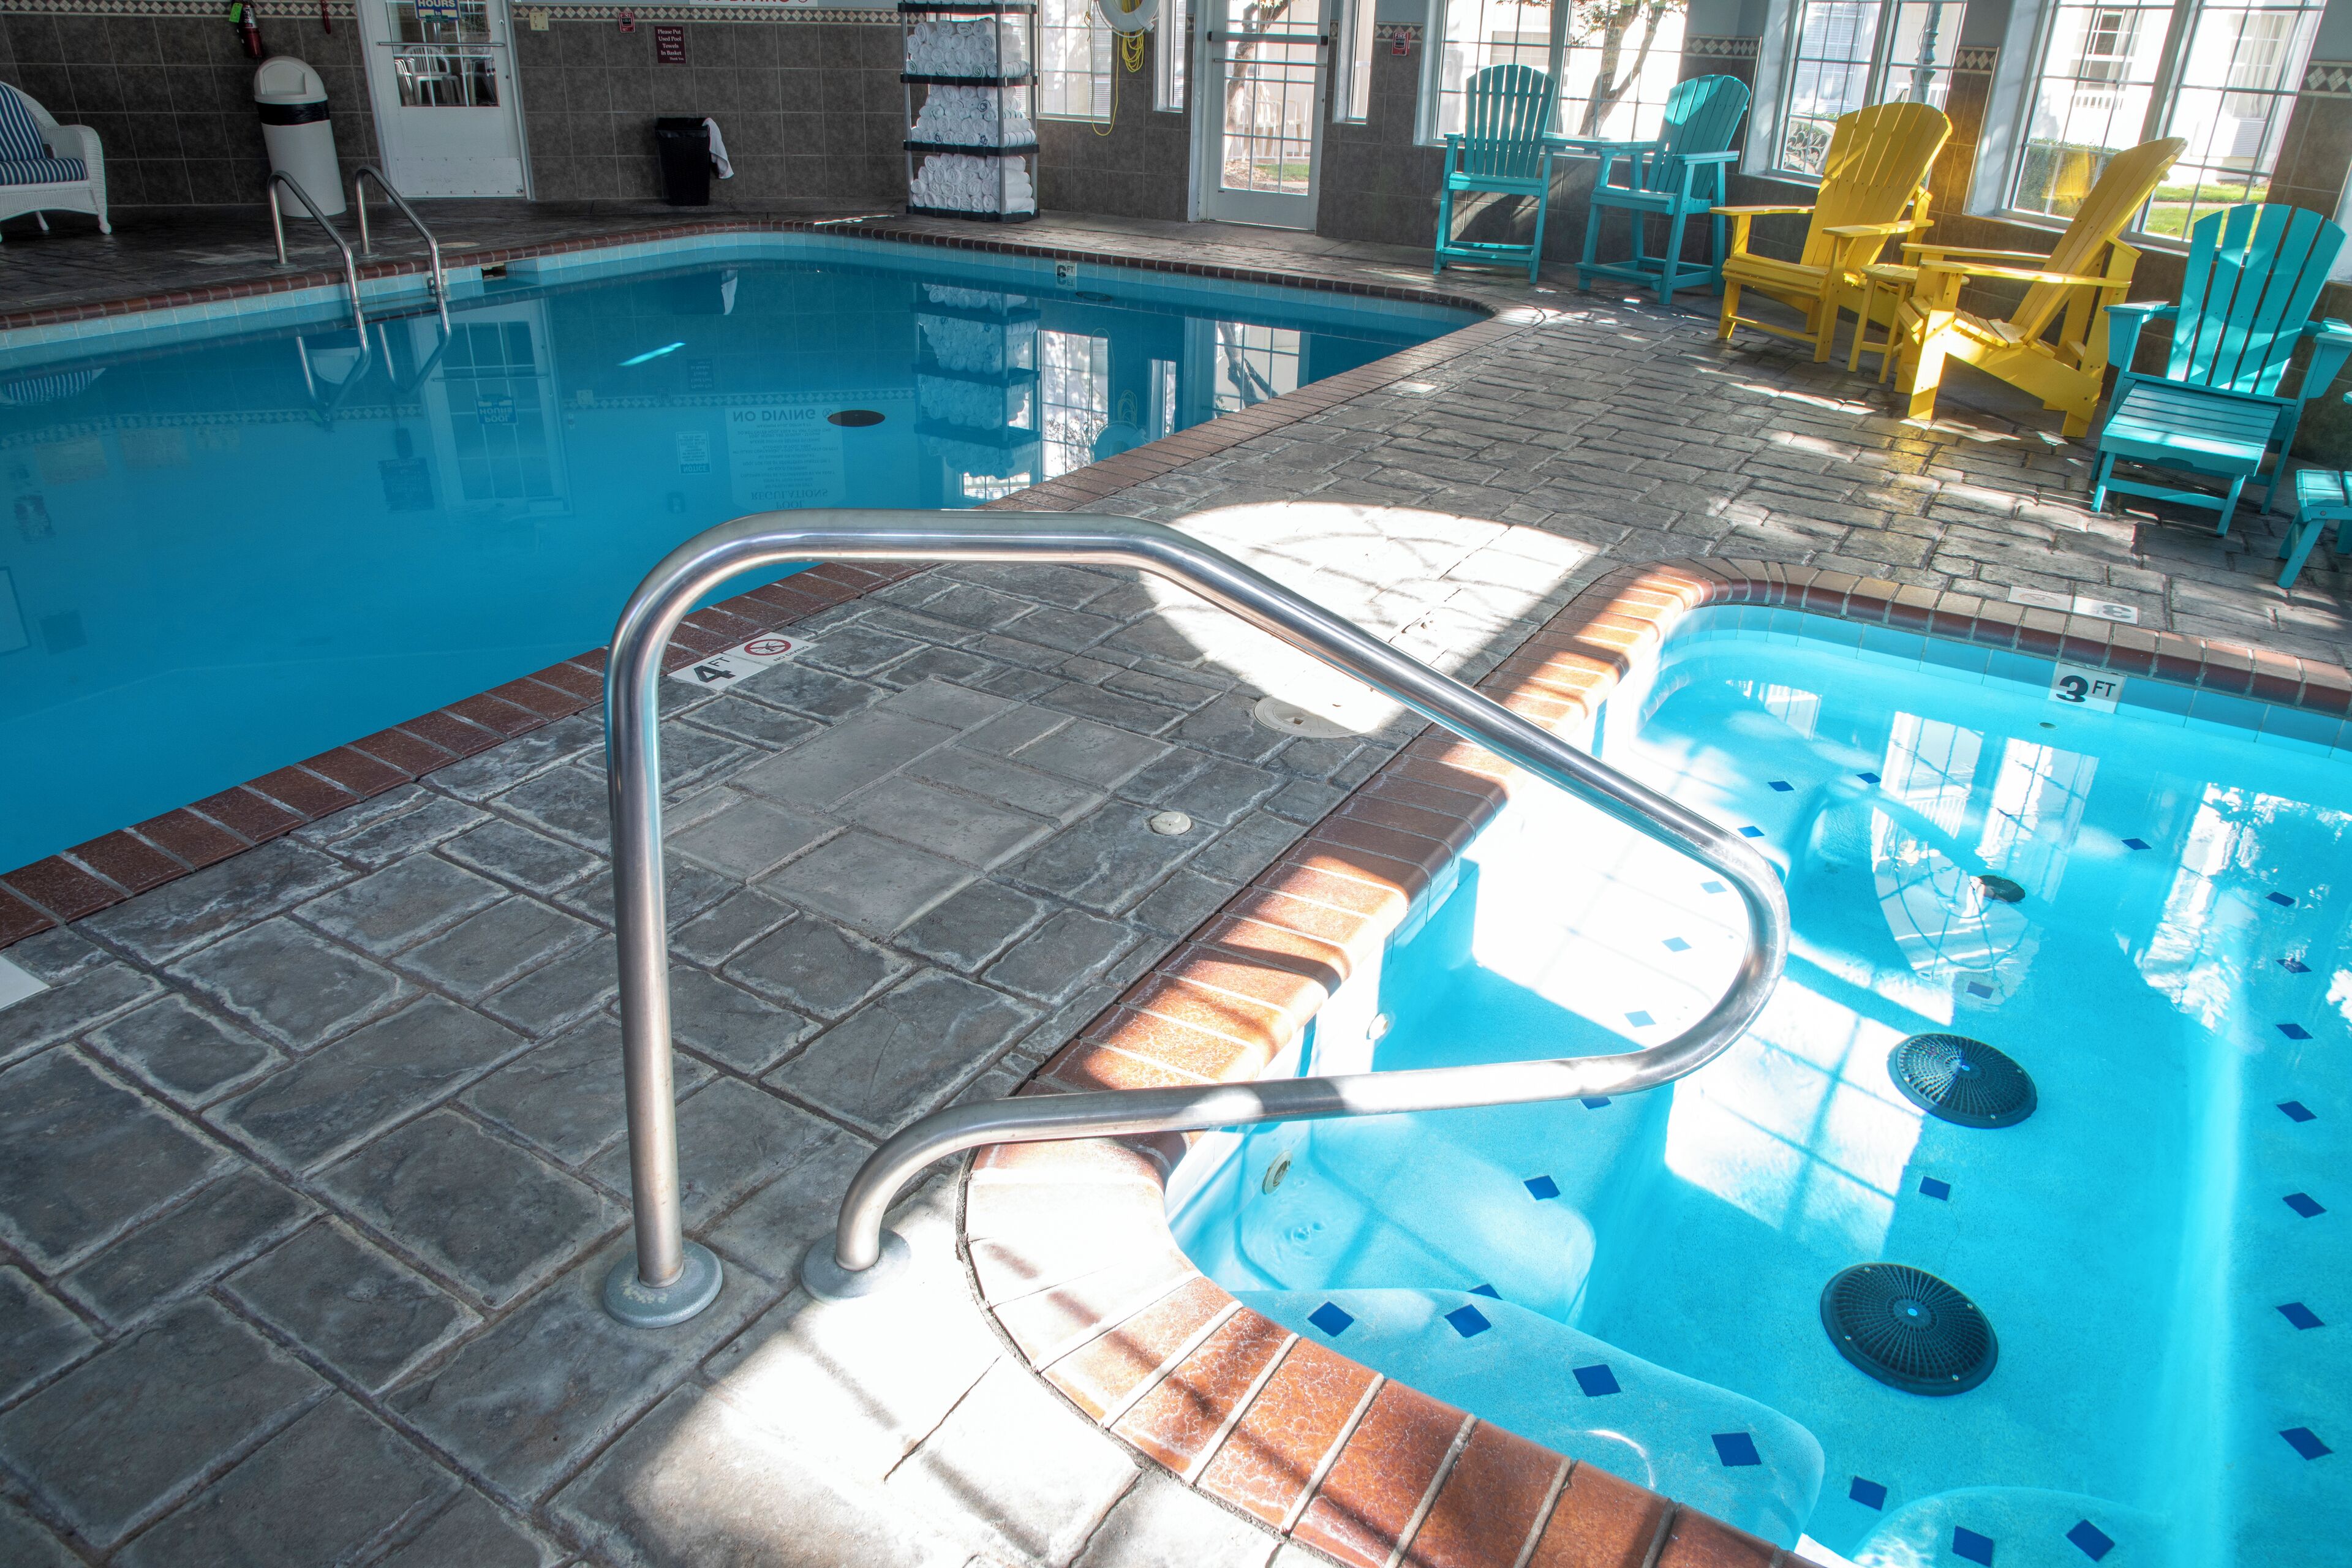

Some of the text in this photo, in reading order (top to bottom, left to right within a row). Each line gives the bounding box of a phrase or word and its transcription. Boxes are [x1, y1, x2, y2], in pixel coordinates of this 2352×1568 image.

[785, 646, 809, 657] DIVING
[693, 657, 736, 683] 4 FT
[2056, 675, 2116, 703] 3 FT
